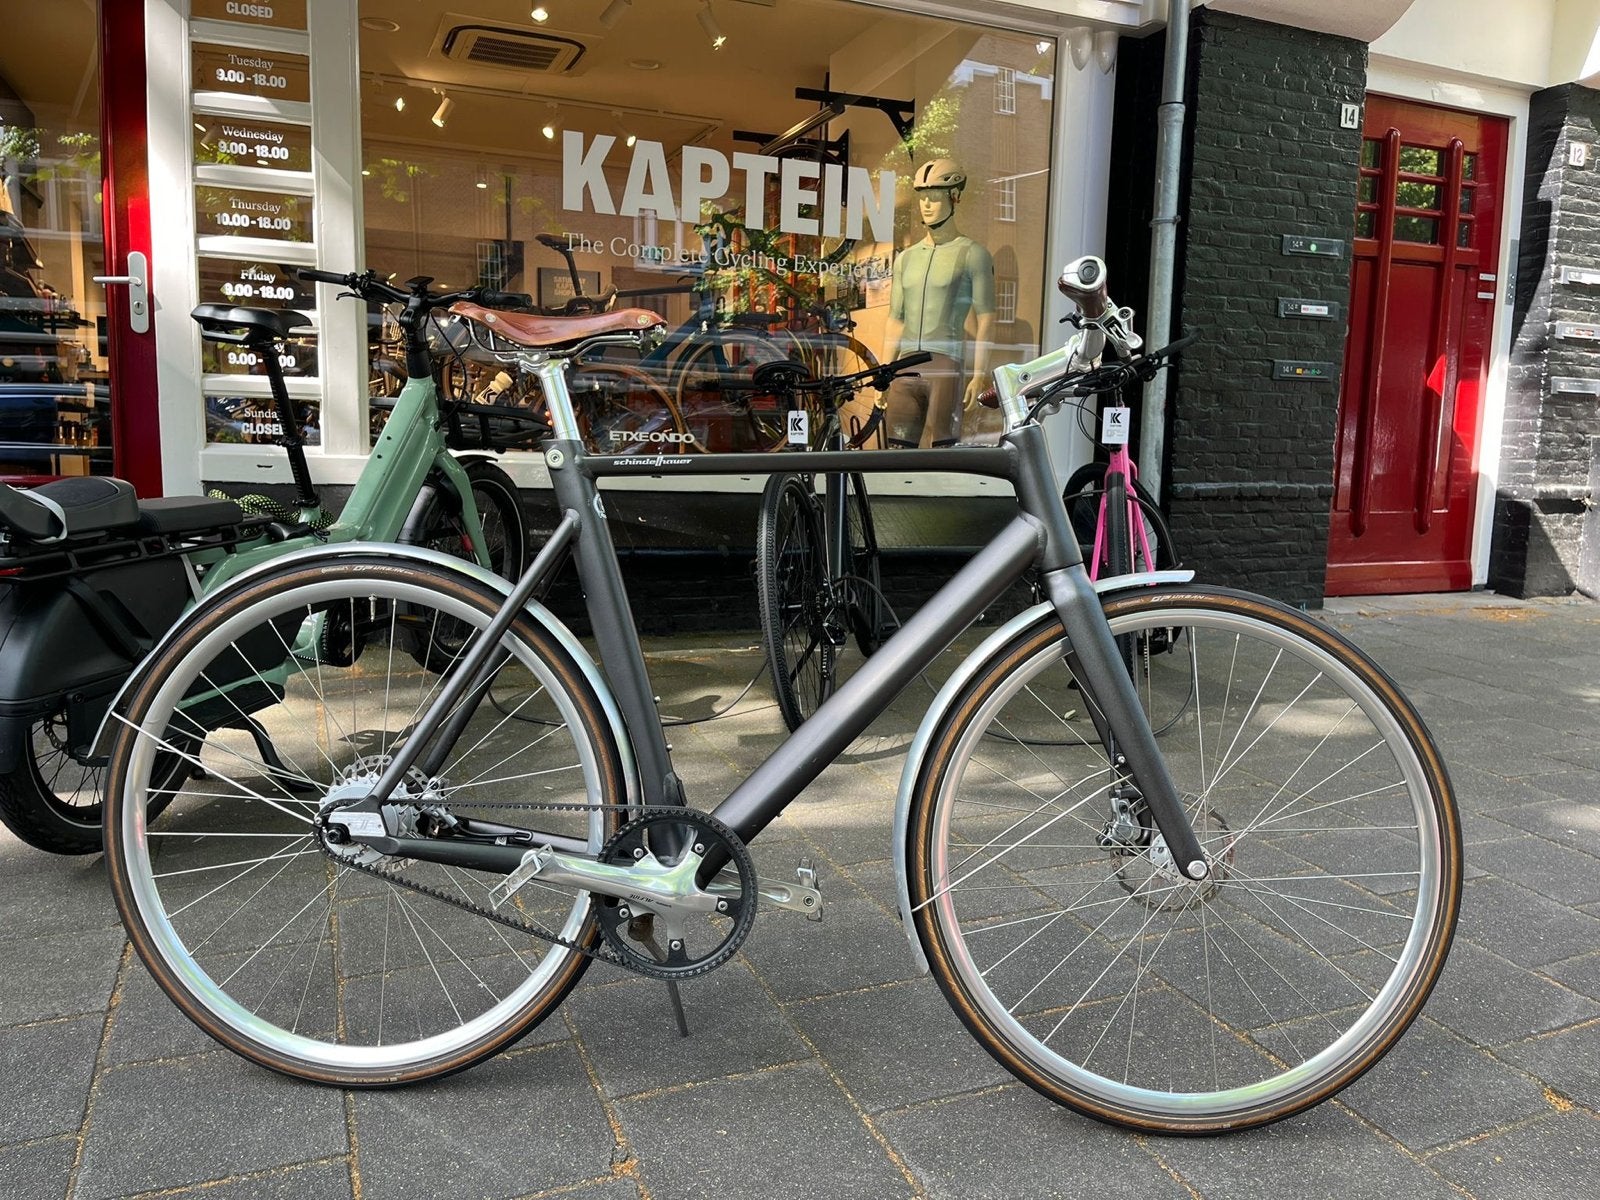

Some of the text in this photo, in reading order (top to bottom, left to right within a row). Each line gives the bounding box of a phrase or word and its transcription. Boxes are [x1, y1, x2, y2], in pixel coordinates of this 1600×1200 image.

[226, 1, 273, 18] CLOSED
[228, 53, 274, 71] Tuesday
[1344, 107, 1355, 126] 14
[222, 126, 284, 144] Wednesday
[1573, 147, 1583, 163] 12
[562, 129, 897, 243] KAPTEIN
[230, 197, 281, 214] Thursday
[562, 232, 604, 254] The
[610, 236, 708, 265] Complete
[713, 247, 788, 277] Cycling
[240, 269, 276, 283] Friday
[244, 408, 280, 421] Sunda
[609, 430, 695, 444] ETXEONDO
[613, 456, 692, 467] schindelhauer
